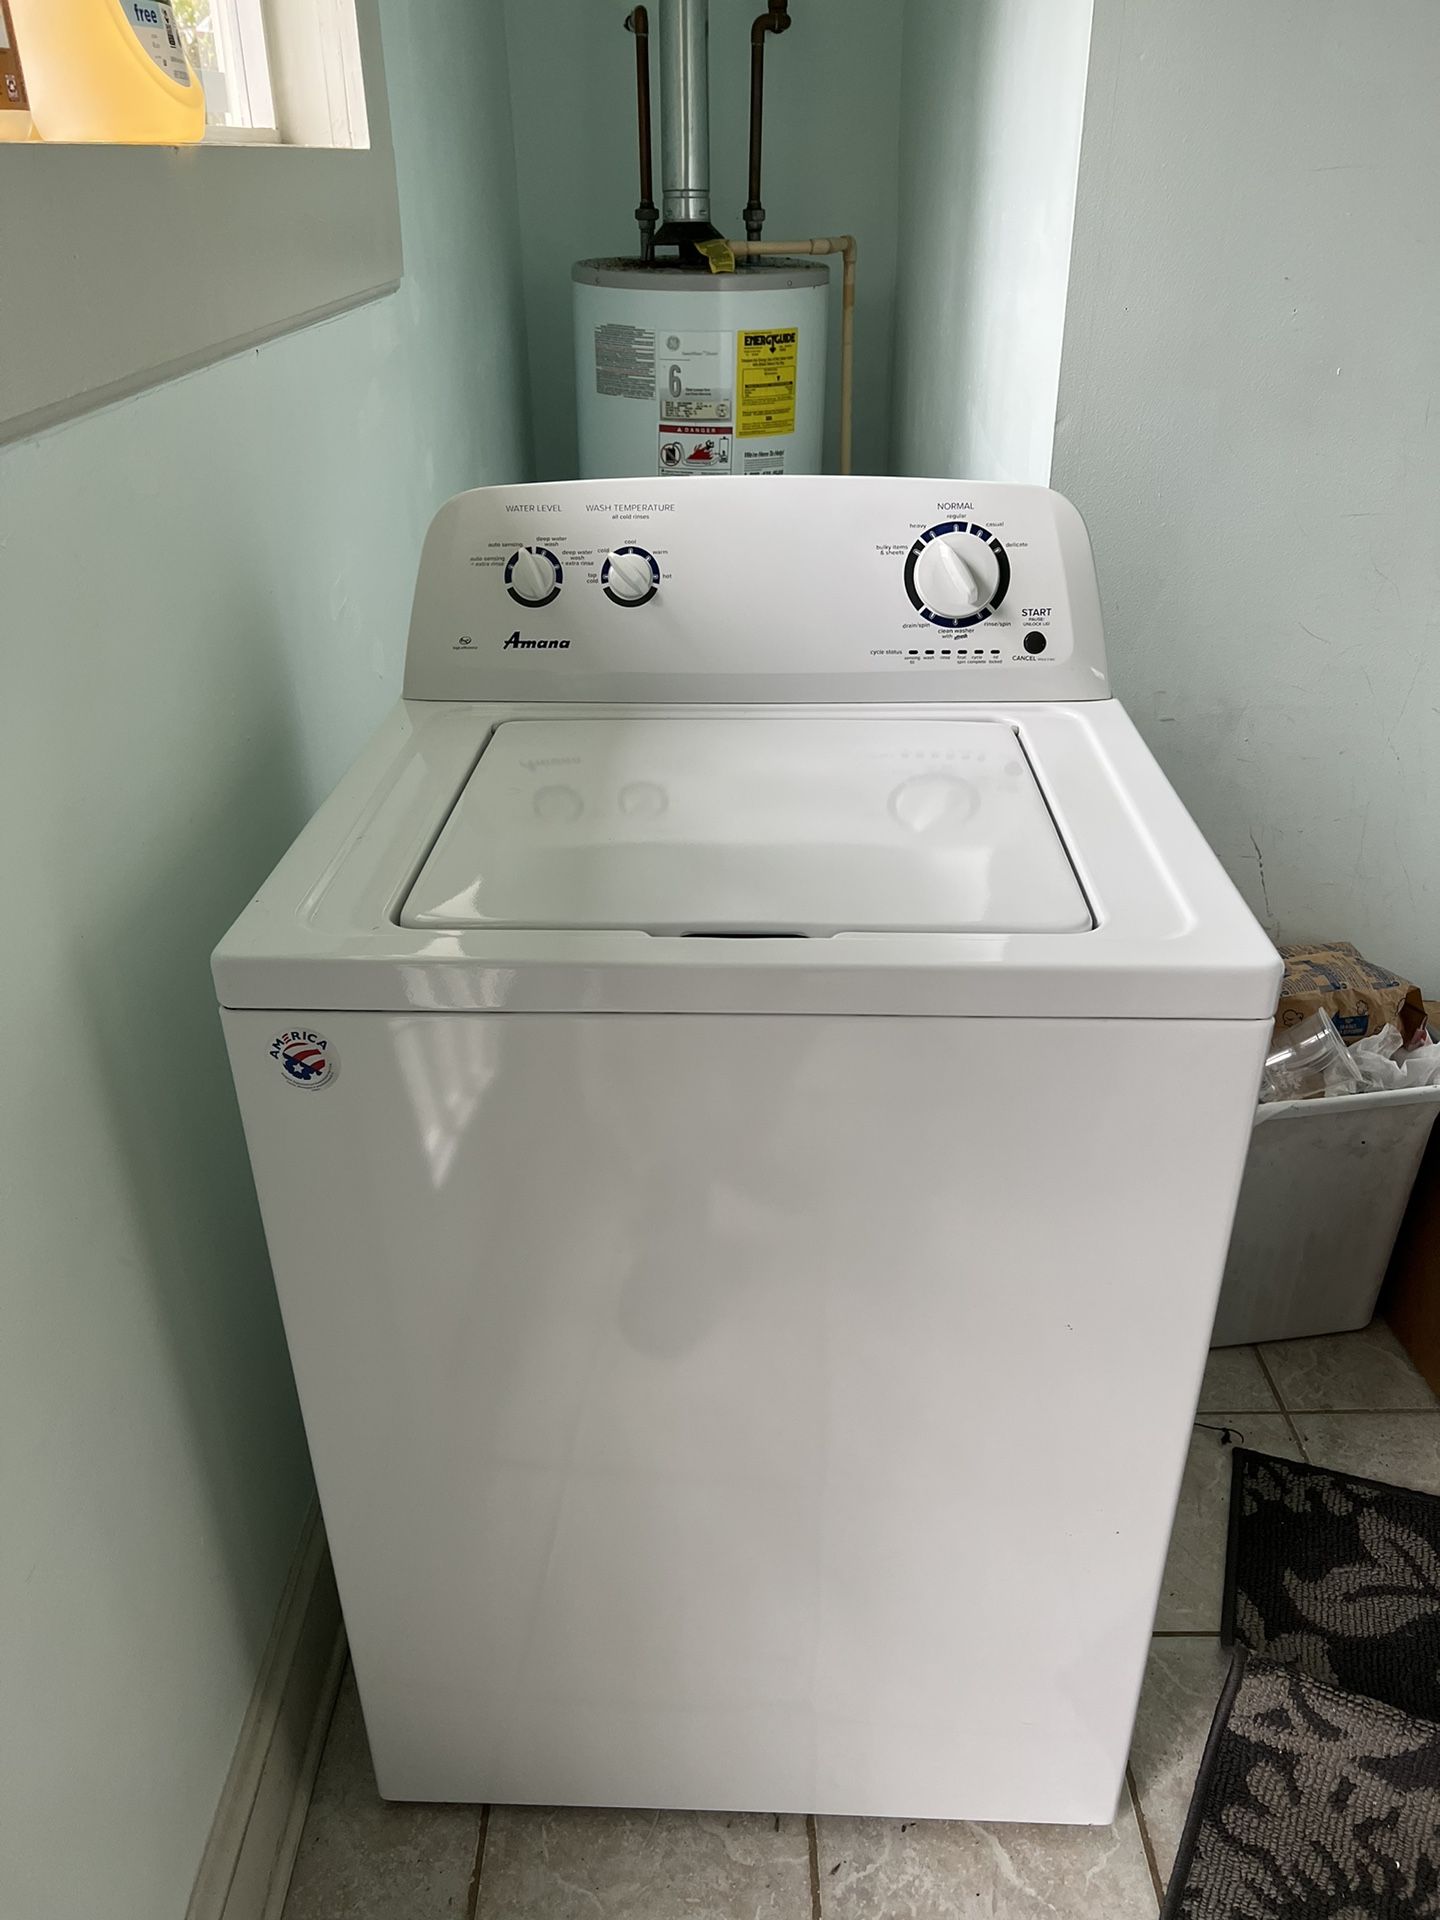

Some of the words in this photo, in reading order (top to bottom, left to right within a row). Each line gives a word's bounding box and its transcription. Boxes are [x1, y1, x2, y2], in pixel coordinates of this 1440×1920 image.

[134, 4, 158, 23] free
[669, 364, 681, 397] 6
[1022, 608, 1052, 617] START
[504, 631, 571, 650] Amana
[270, 1031, 328, 1059] AMERICA
